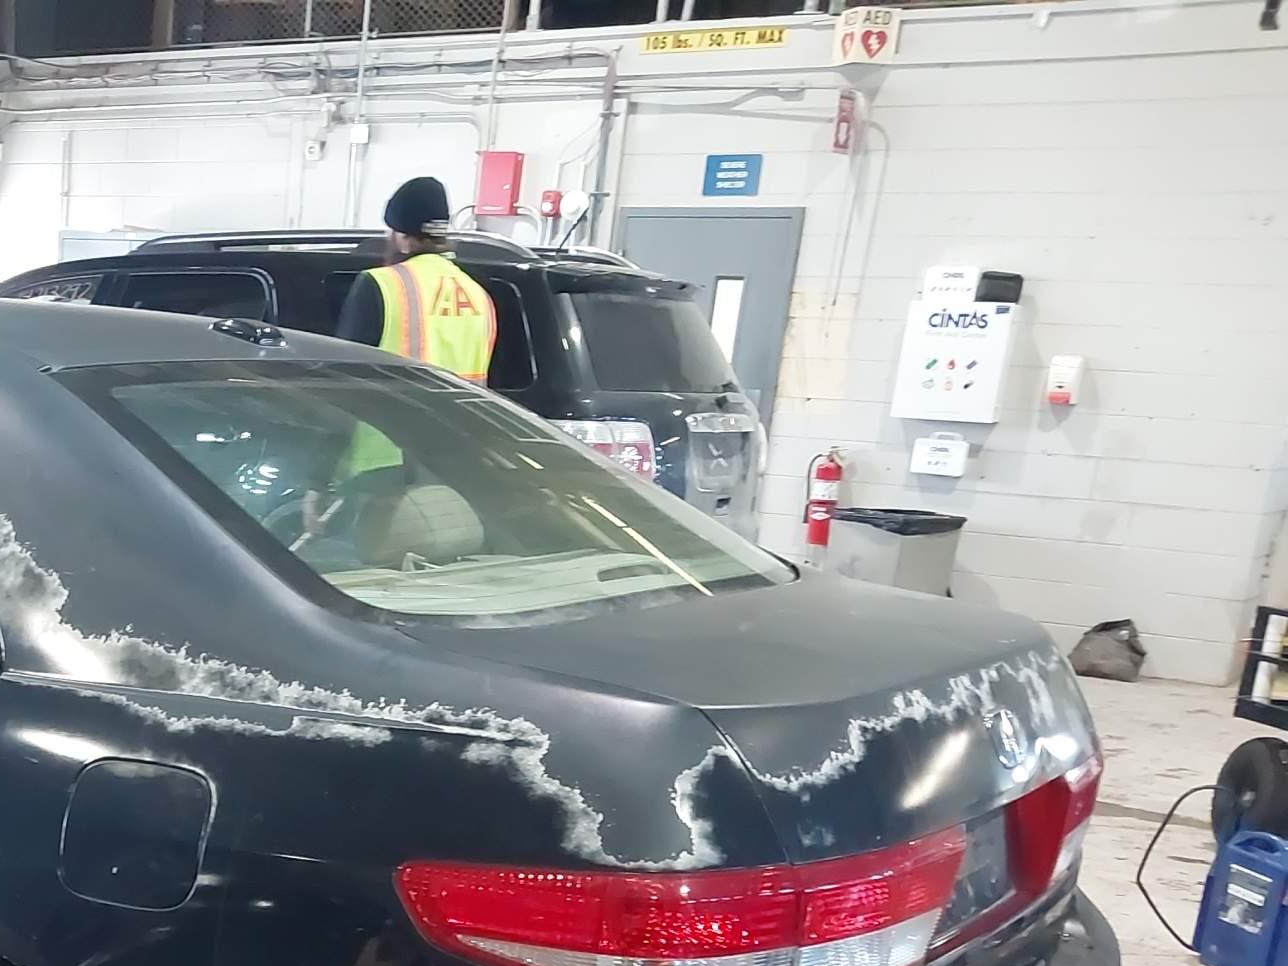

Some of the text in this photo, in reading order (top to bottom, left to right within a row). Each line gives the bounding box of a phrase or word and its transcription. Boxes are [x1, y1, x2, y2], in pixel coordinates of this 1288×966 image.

[863, 10, 892, 25] AED
[646, 36, 667, 50] 105
[708, 33, 728, 47] SQ.
[734, 31, 750, 45] FT.
[757, 29, 784, 44] MAX
[928, 308, 988, 329] CINTAS
